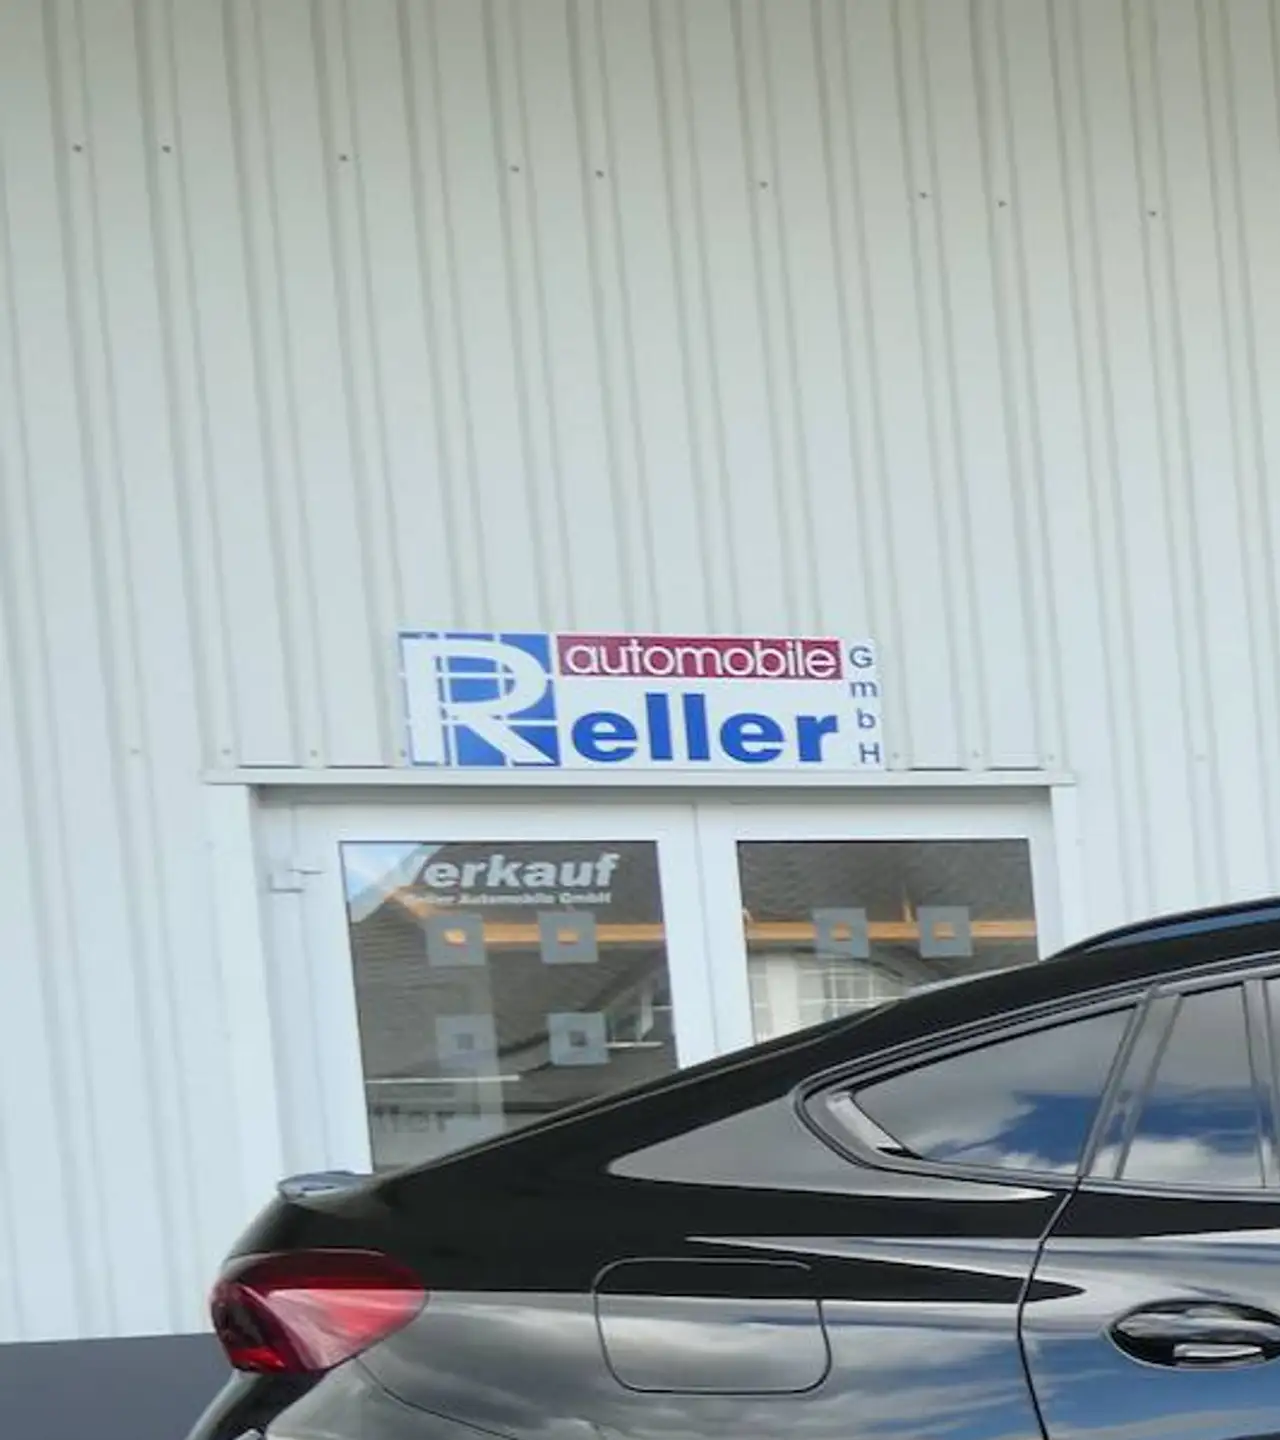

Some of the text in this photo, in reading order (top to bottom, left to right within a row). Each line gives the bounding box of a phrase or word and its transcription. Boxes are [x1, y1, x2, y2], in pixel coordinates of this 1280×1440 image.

[401, 637, 839, 765] Reller
[565, 639, 837, 678] automobile
[849, 647, 881, 764] GmbH
